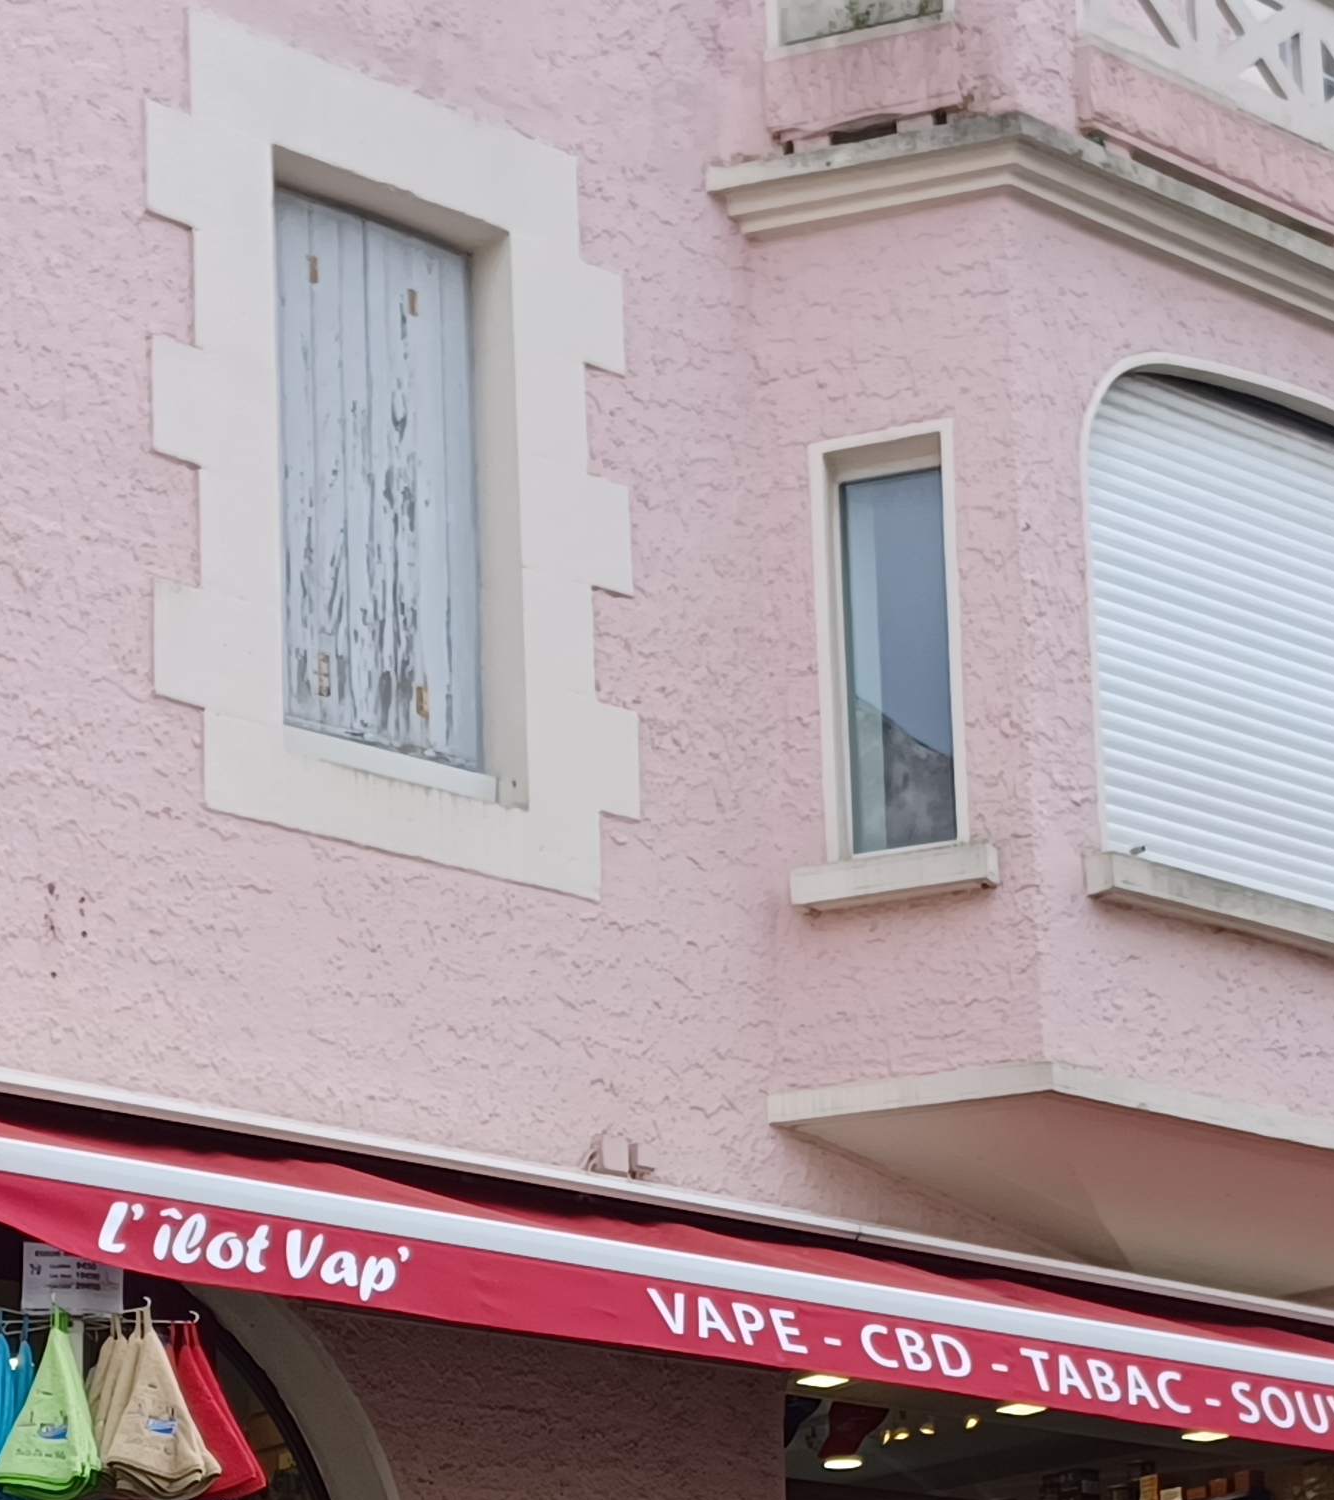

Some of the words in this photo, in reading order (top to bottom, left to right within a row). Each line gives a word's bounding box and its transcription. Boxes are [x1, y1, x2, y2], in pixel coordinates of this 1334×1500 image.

[97, 1200, 271, 1274] L'îlot
[285, 1228, 411, 1302] Vap'
[646, 1287, 809, 1355] VAPE
[860, 1323, 973, 1379] CBD
[1019, 1347, 1192, 1415] TABAC
